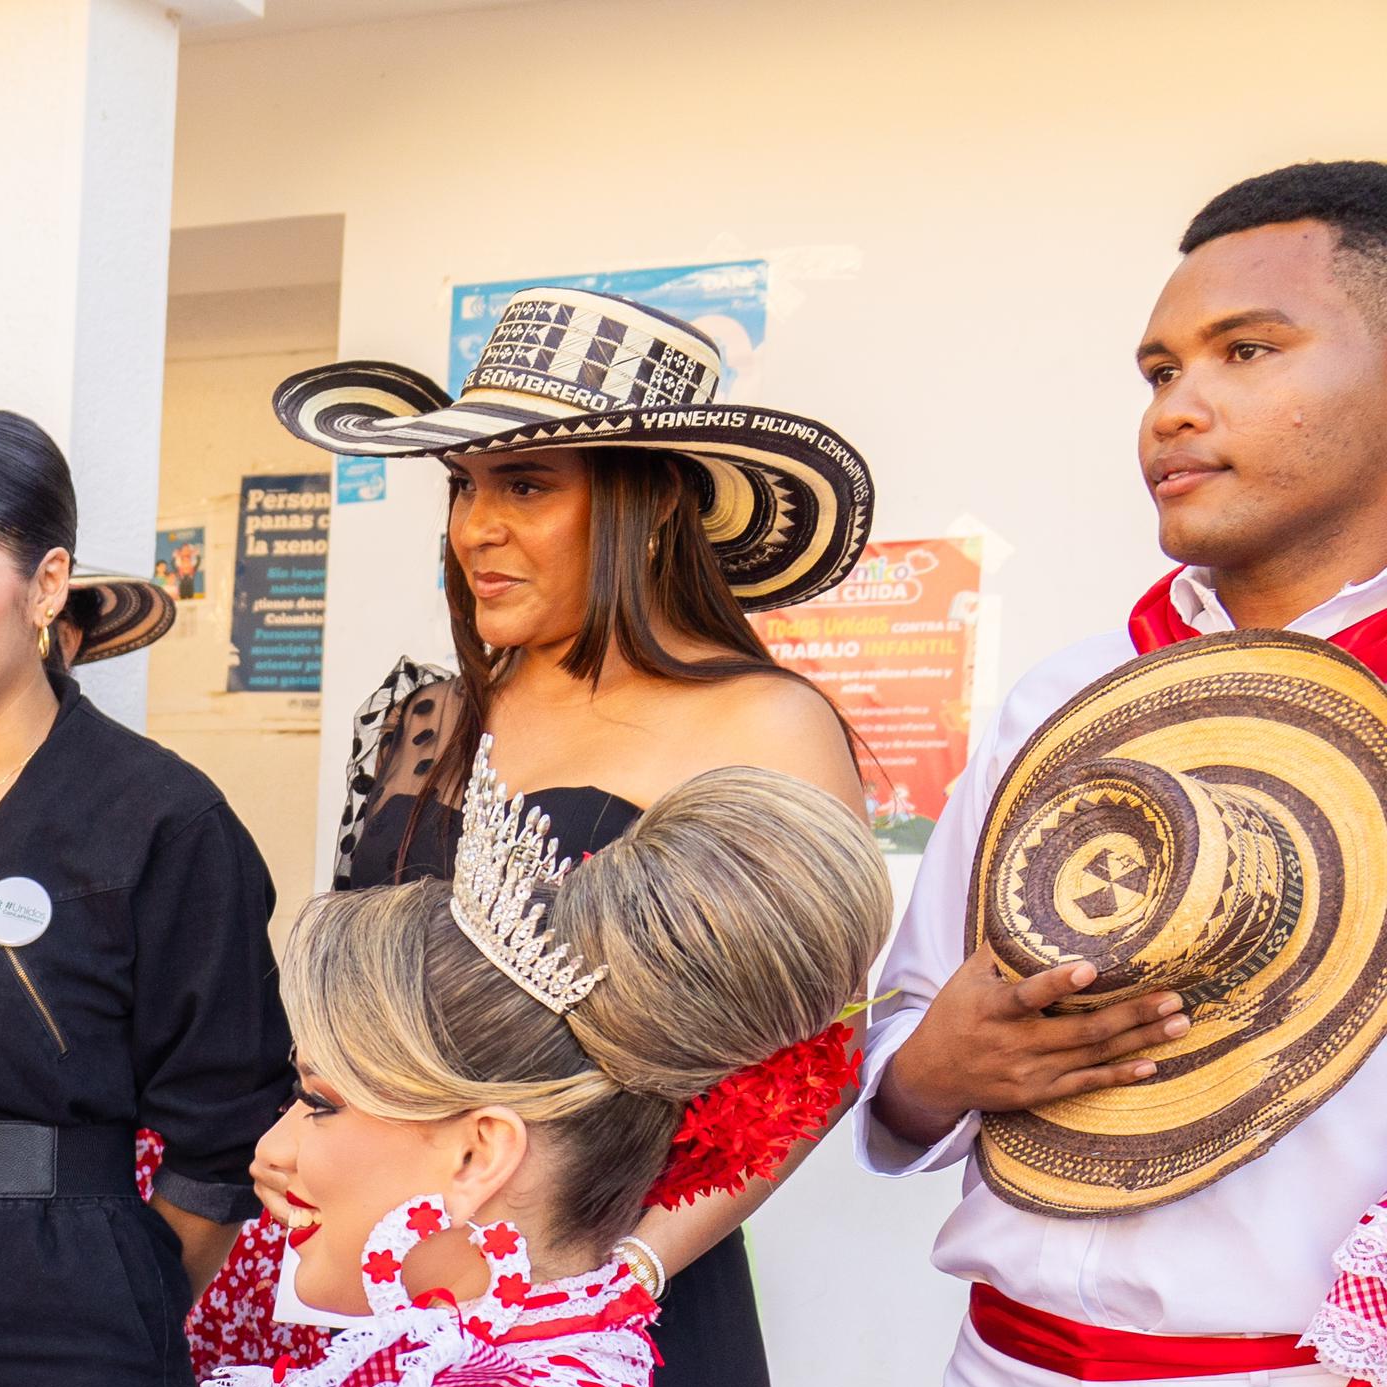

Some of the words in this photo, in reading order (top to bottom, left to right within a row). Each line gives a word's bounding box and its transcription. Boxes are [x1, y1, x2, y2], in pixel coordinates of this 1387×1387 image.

[479, 369, 609, 411] SOMBRERO
[641, 410, 748, 430] YANERIS
[817, 434, 870, 505] CERVANTES
[247, 489, 330, 512] Person
[246, 514, 314, 535] panas
[246, 535, 268, 556] la
[272, 539, 327, 556] xeno
[841, 583, 909, 601] CUIDA
[890, 621, 945, 635] CONTRA
[946, 620, 963, 632] EL
[770, 641, 860, 661] TRABAJO
[864, 638, 958, 656] INFANTIL
